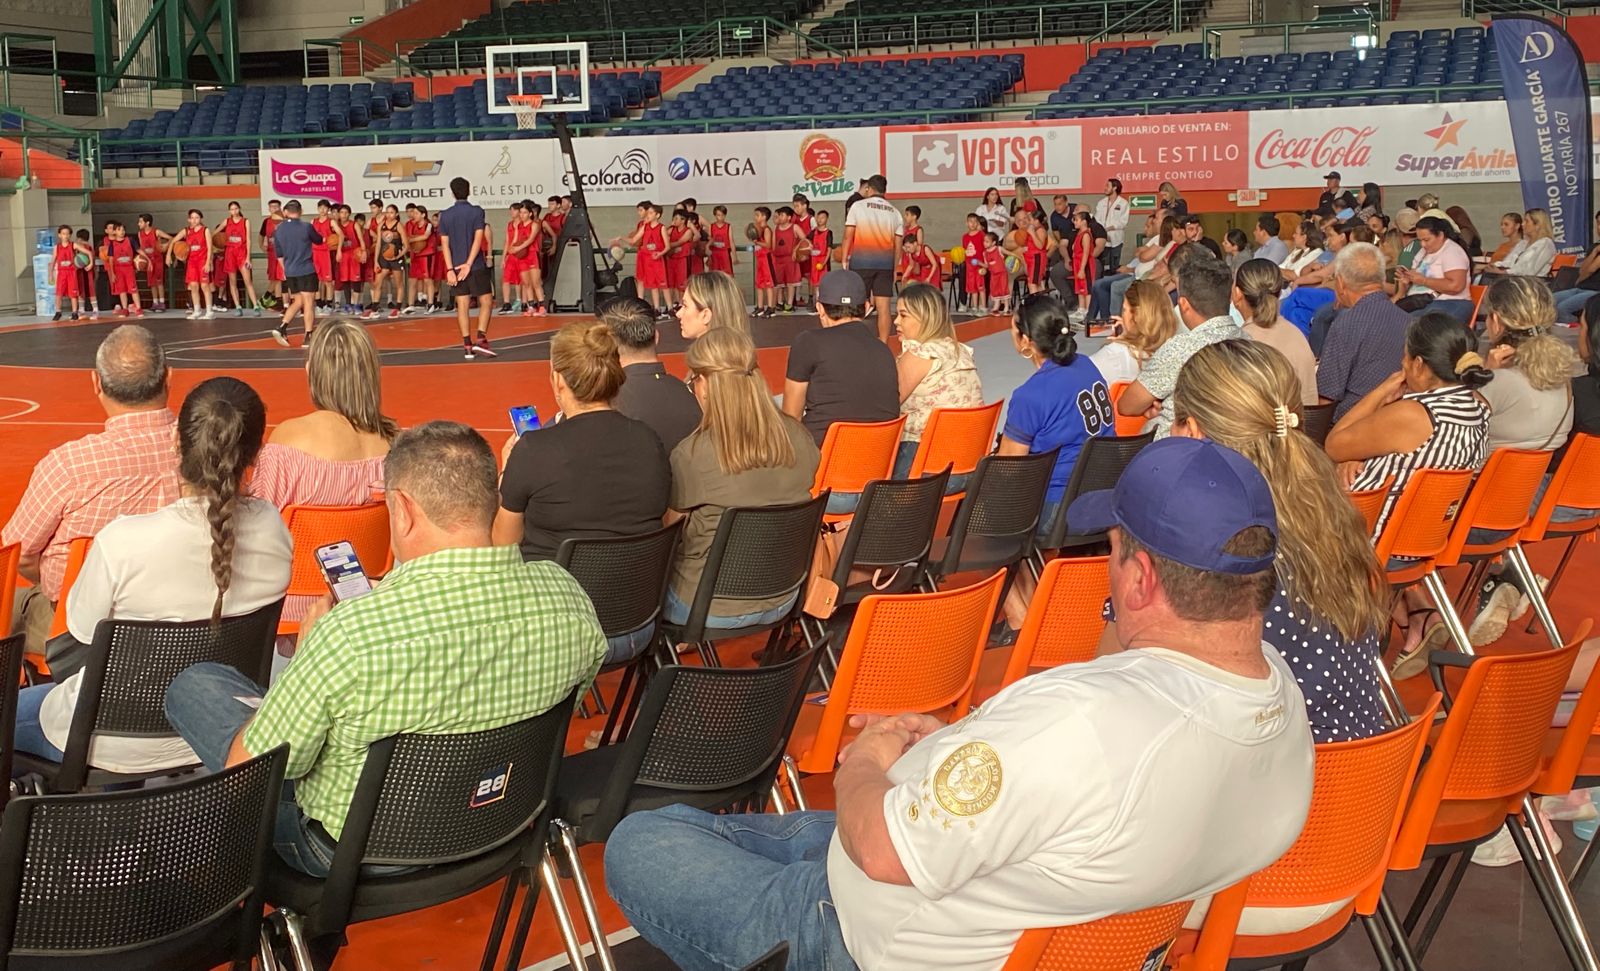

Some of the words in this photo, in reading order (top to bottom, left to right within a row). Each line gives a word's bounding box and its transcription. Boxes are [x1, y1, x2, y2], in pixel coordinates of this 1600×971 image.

[1525, 70, 1548, 125] GARCÍA
[1099, 125, 1160, 136] MOBILIARIO
[1162, 124, 1176, 134] DE
[1178, 122, 1213, 133] VENTA
[1214, 122, 1232, 132] EN:
[1554, 111, 1571, 134] 267
[961, 135, 1045, 177] versa
[1091, 147, 1148, 166] REAL
[1158, 143, 1240, 164] ESTILO
[1254, 126, 1379, 169] Coca-Cola
[1537, 126, 1558, 183] DUARTE
[275, 171, 290, 184] La
[290, 169, 337, 186] Guapa
[692, 157, 757, 178] MEGA
[1115, 171, 1160, 182] SIEMPRE
[1164, 170, 1213, 180] CONTIGO
[1470, 169, 1483, 177] del
[1484, 168, 1511, 176] ahorro
[1557, 136, 1579, 197] NOTARÍA
[363, 187, 447, 200] CHEVROLET
[472, 185, 496, 197] EAL
[500, 184, 544, 196] ESTILO
[792, 182, 810, 194] Del
[809, 178, 855, 198] Valle
[1546, 186, 1566, 243] ARTURO
[1076, 381, 1114, 437] 88
